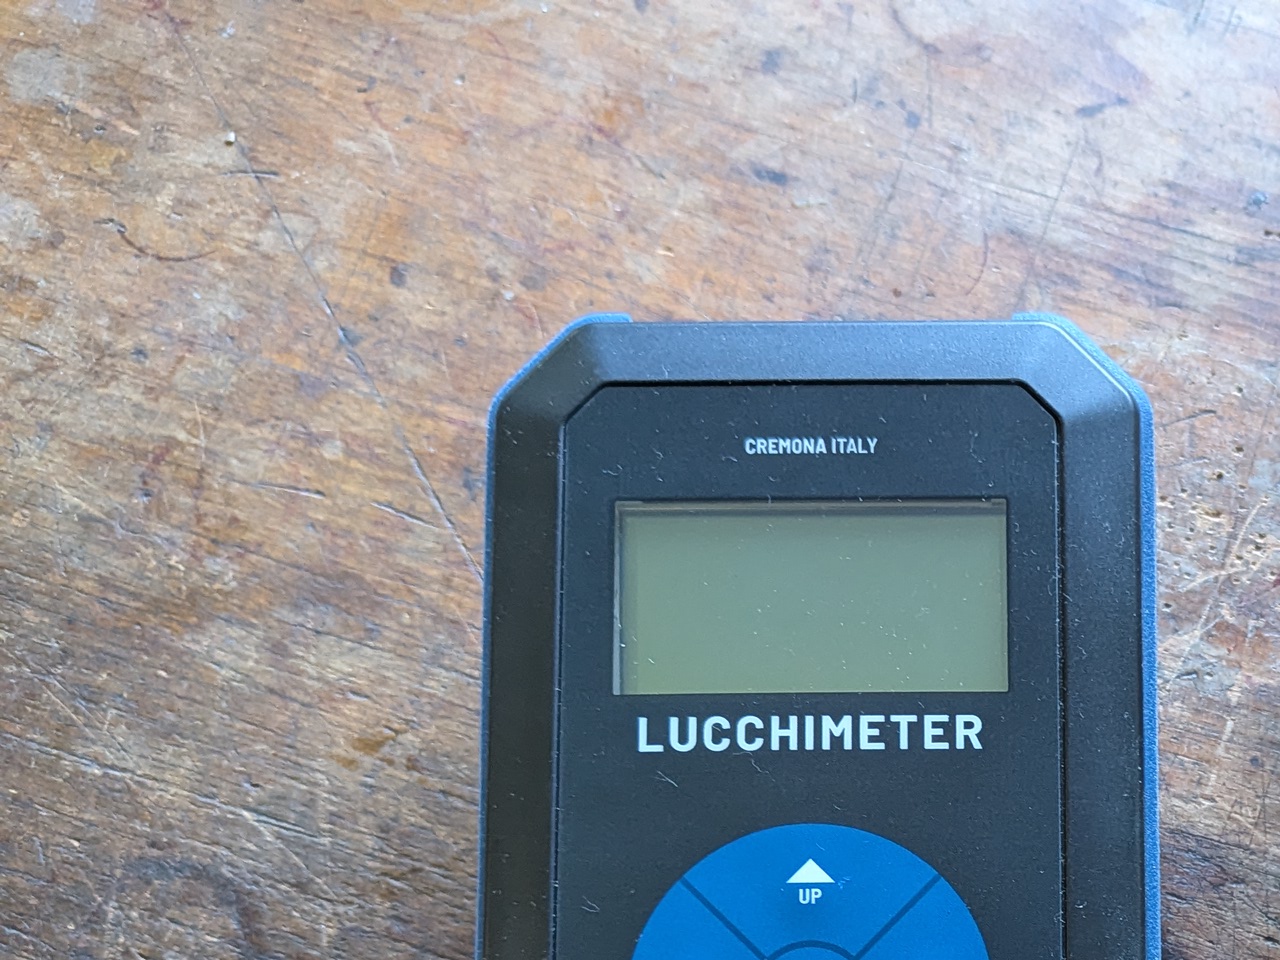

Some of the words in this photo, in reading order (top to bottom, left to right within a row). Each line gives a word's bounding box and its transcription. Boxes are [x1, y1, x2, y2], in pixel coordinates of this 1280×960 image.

[744, 437, 828, 454] CREMONA
[831, 437, 878, 454] ITALY
[636, 714, 984, 753] LUCCHIMETER
[798, 888, 822, 905] UP
